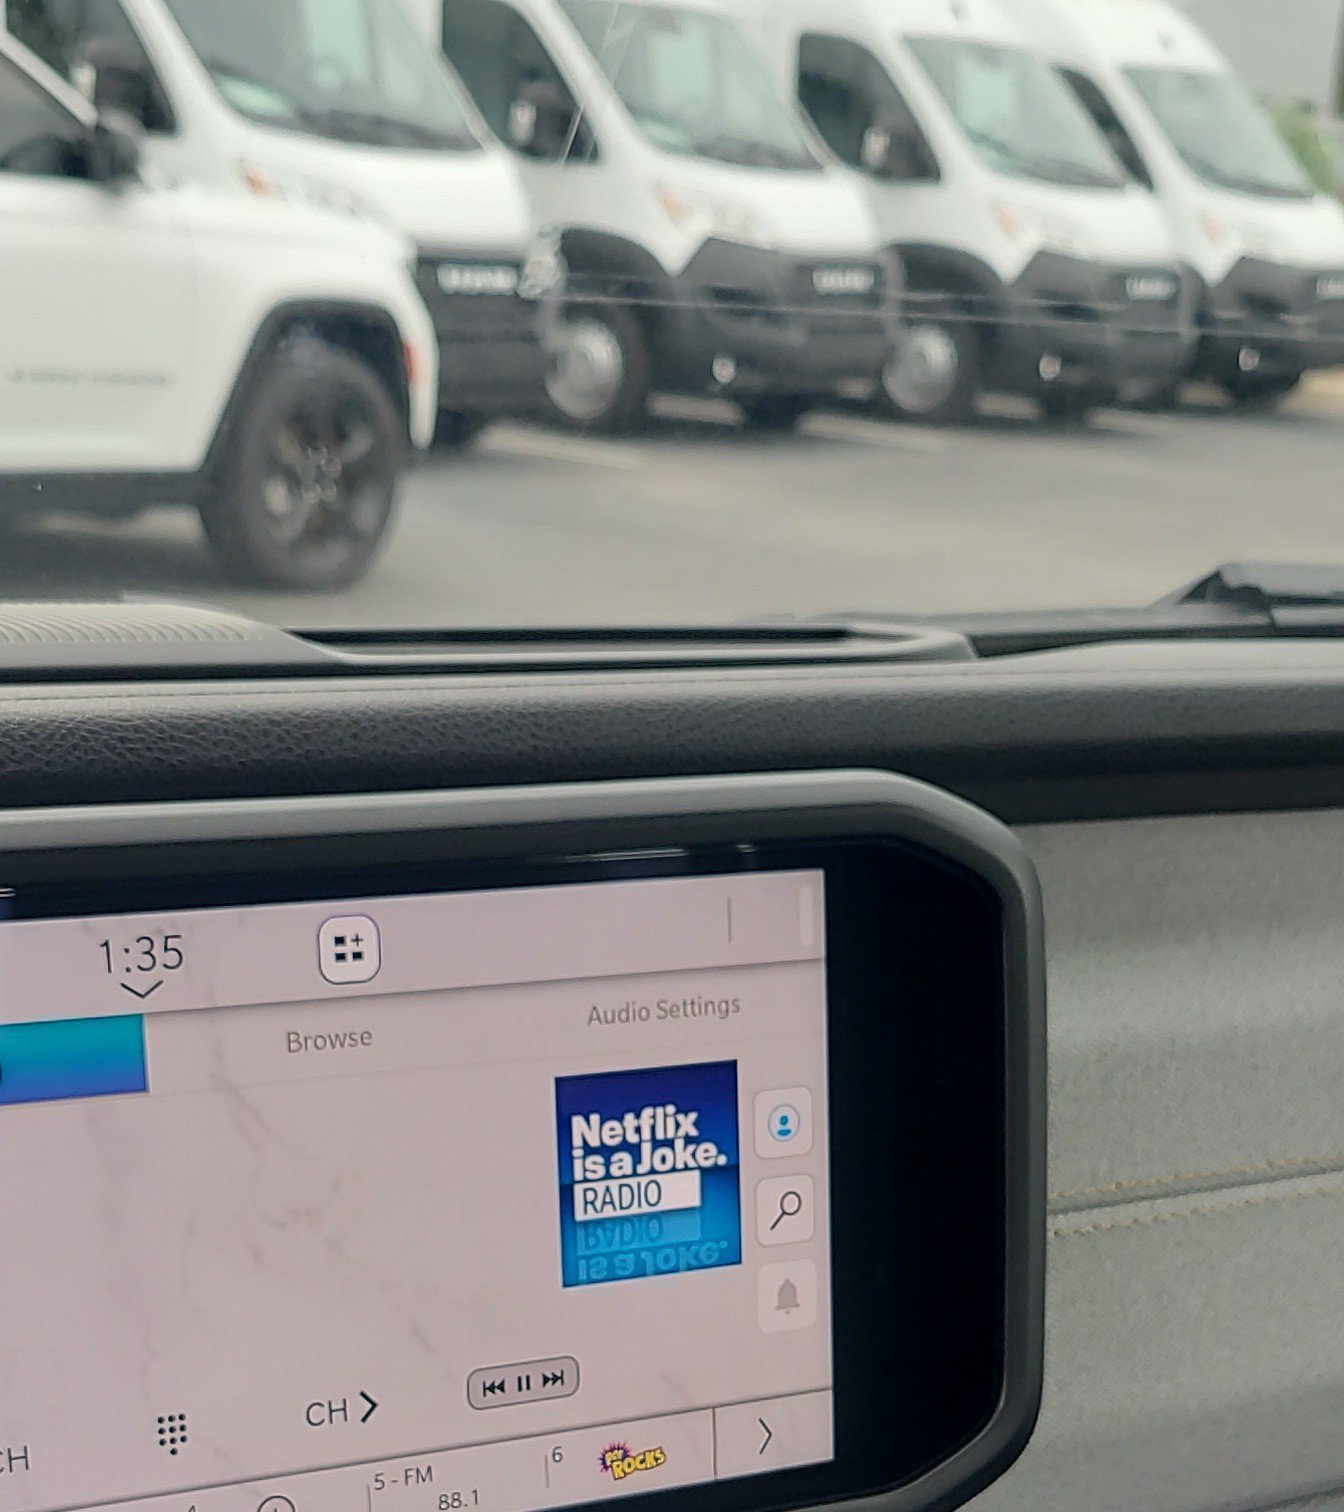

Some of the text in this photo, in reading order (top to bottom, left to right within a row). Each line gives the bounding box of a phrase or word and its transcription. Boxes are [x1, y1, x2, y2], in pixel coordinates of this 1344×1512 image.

[99, 934, 184, 975] 1:35
[587, 994, 742, 1027] Audio Settings
[286, 1028, 374, 1054] Browse
[570, 1104, 700, 1149] Netflix
[572, 1138, 729, 1182] is a Joke.
[582, 1179, 663, 1216] RADIO
[306, 1398, 349, 1427] CH
[551, 1446, 564, 1463] 6
[374, 1472, 387, 1491] 5
[404, 1466, 435, 1487] FM
[437, 1489, 480, 1511] 88.1
